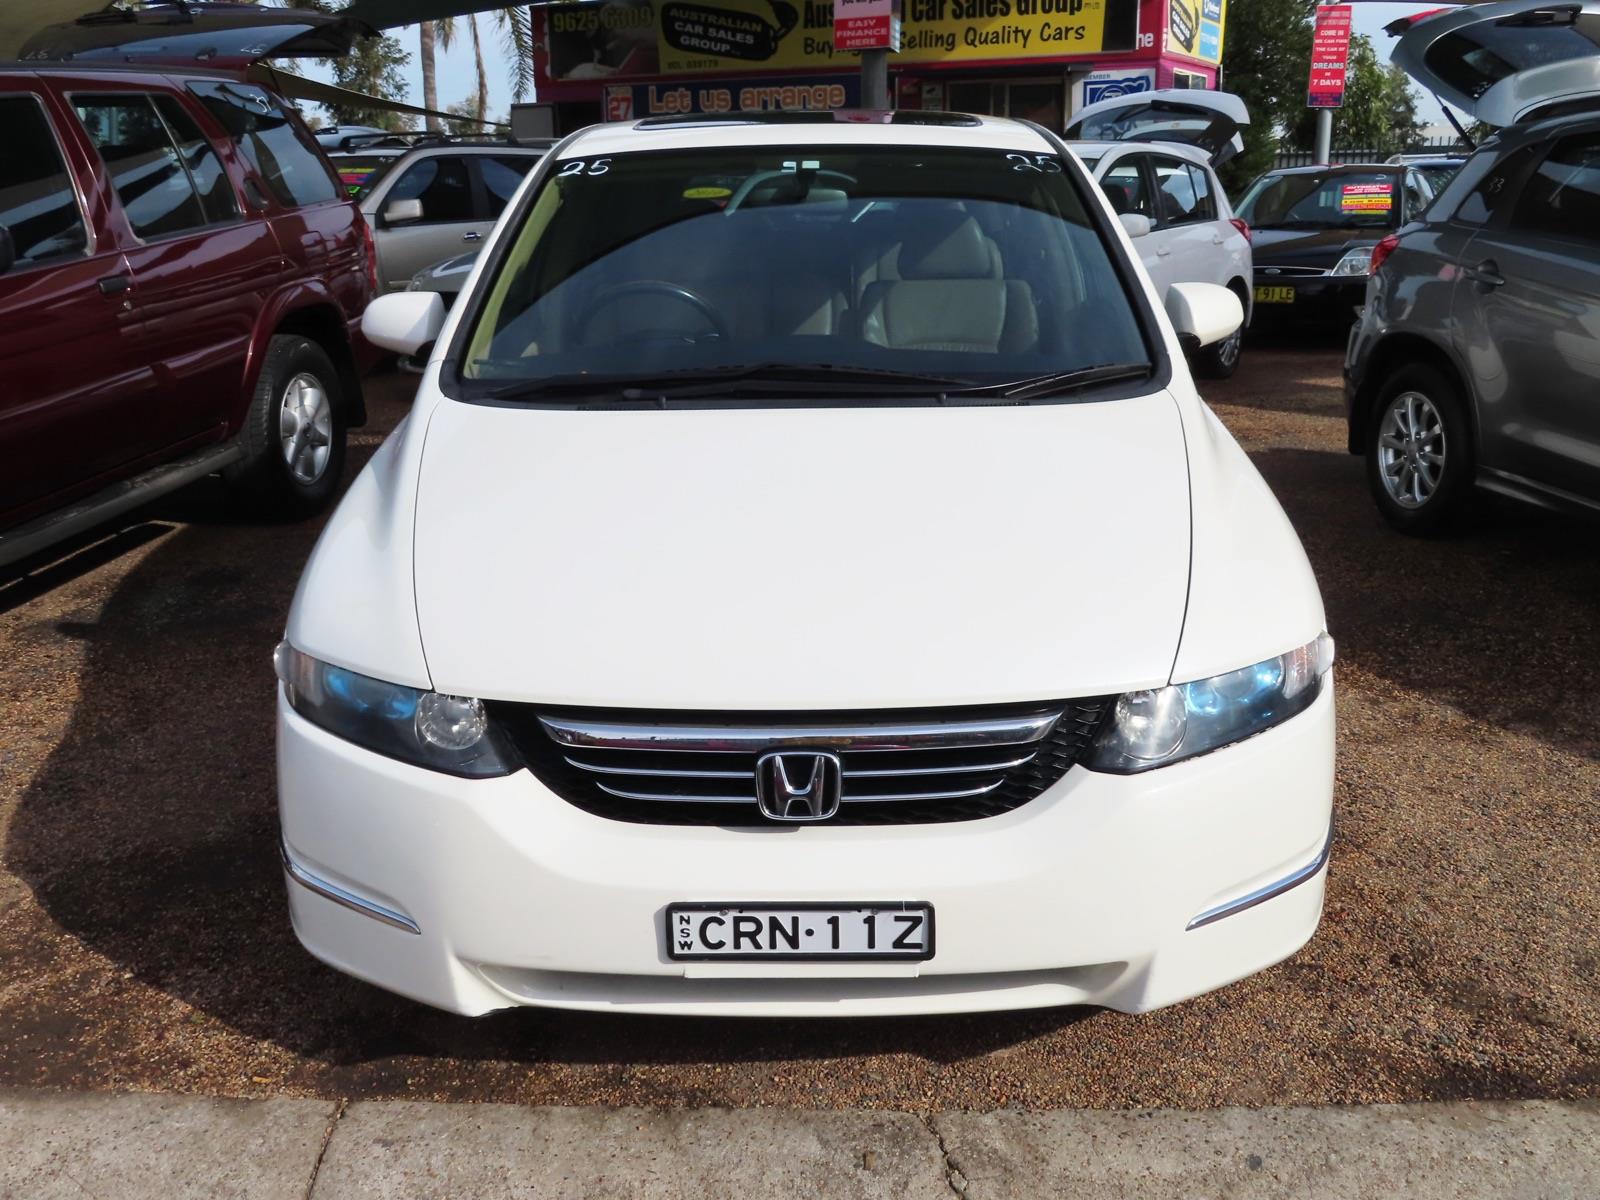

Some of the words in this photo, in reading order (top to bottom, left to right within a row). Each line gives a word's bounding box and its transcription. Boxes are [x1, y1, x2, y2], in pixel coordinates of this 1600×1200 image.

[553, 10, 599, 32] 9625
[669, 7, 763, 32] AUSTRALIAN
[912, 0, 947, 21] Car
[952, 0, 1011, 19] Sales
[1017, 0, 1083, 16] Group
[673, 21, 704, 34] CAR
[707, 28, 755, 45] SALES
[836, 28, 888, 38] FINANCE
[847, 19, 877, 28] EASY
[680, 35, 731, 53] GROUP
[846, 38, 877, 46] HERE
[964, 25, 1031, 48] Quality
[1040, 22, 1085, 41] Cars
[609, 96, 631, 121] 27
[649, 86, 691, 113] Let
[700, 88, 731, 111] us
[740, 84, 847, 110] arrange
[557, 158, 612, 176] 25
[1006, 154, 1062, 173] 25
